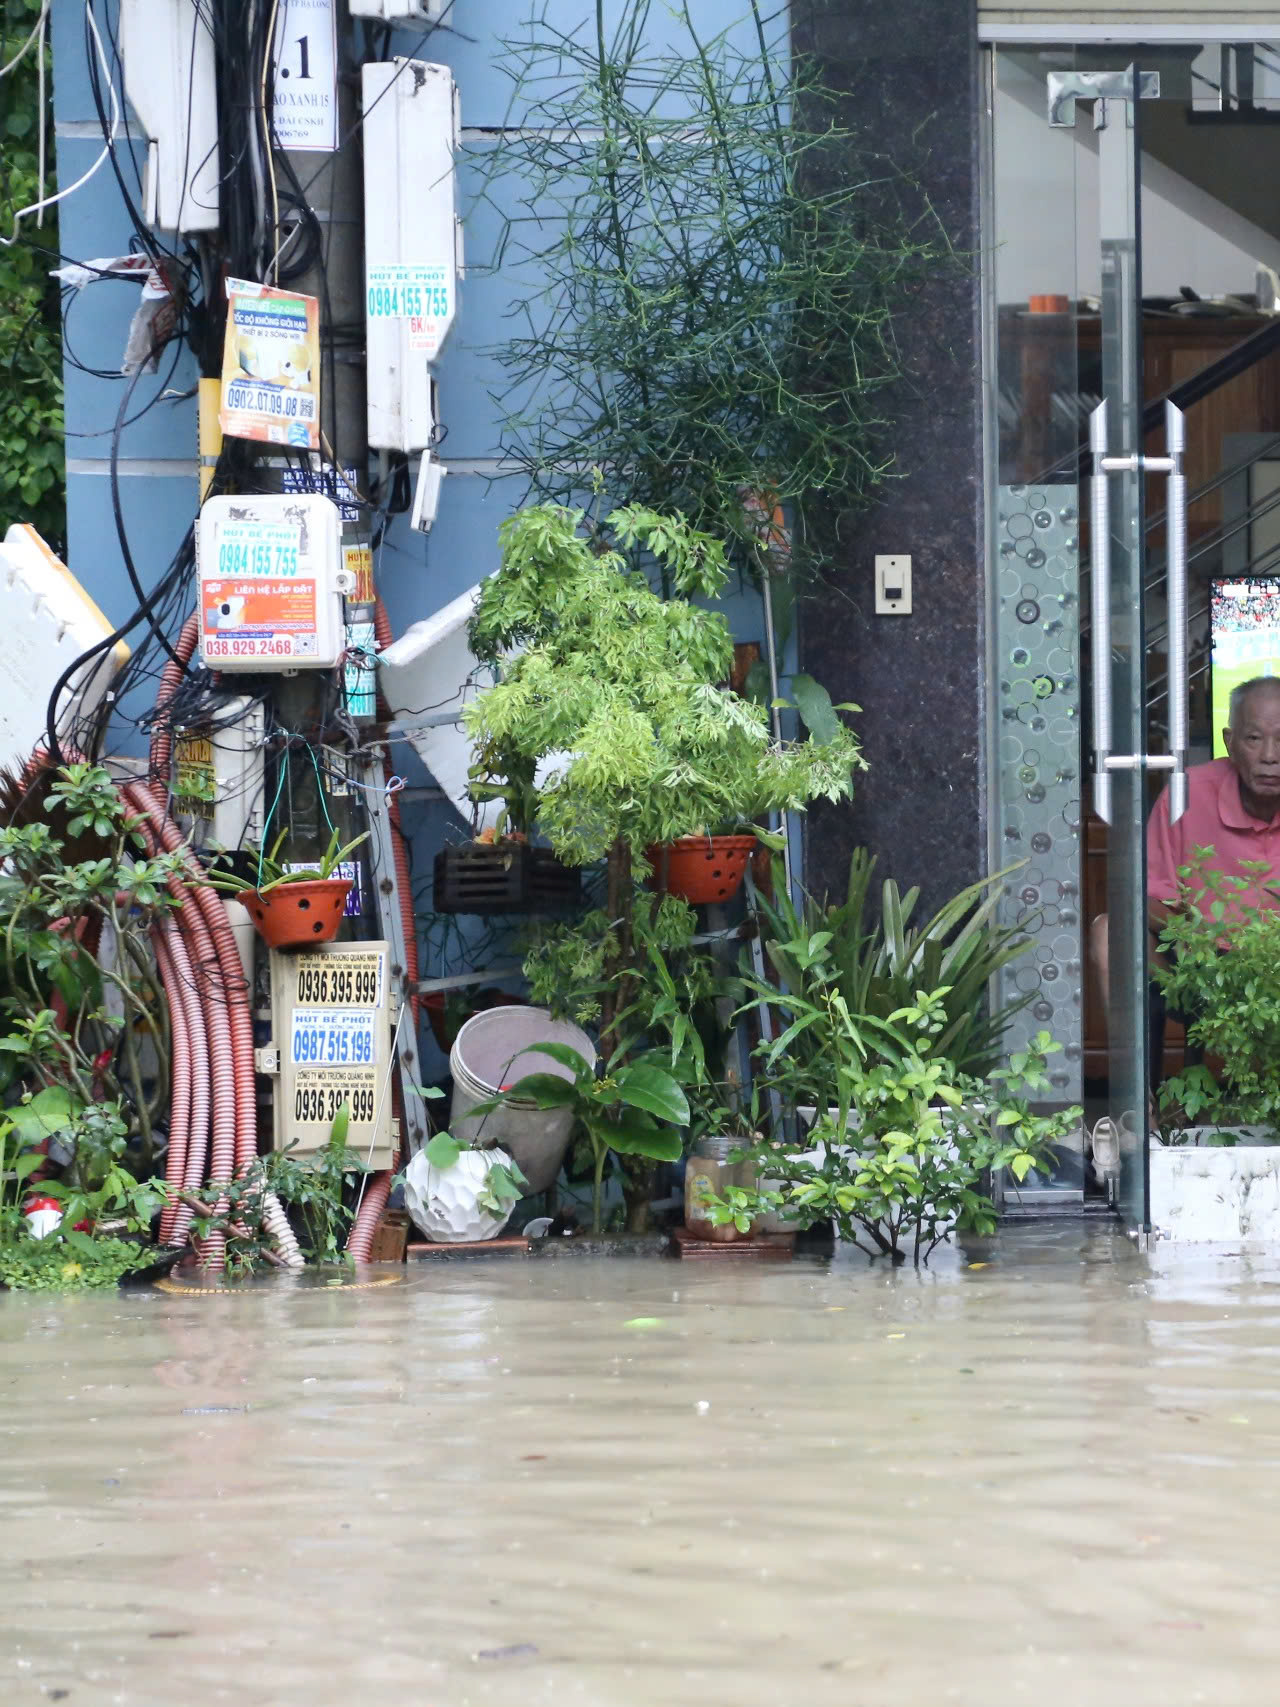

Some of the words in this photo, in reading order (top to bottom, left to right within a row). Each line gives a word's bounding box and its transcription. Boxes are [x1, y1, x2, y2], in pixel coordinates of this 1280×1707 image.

[227, 388, 298, 417] 0902.07.09.08
[206, 640, 292, 656] 038.929.2468
[298, 969, 377, 1003] 0936.395.999
[295, 1013, 319, 1023] HÚT
[294, 1029, 372, 1062] 0987.515.198
